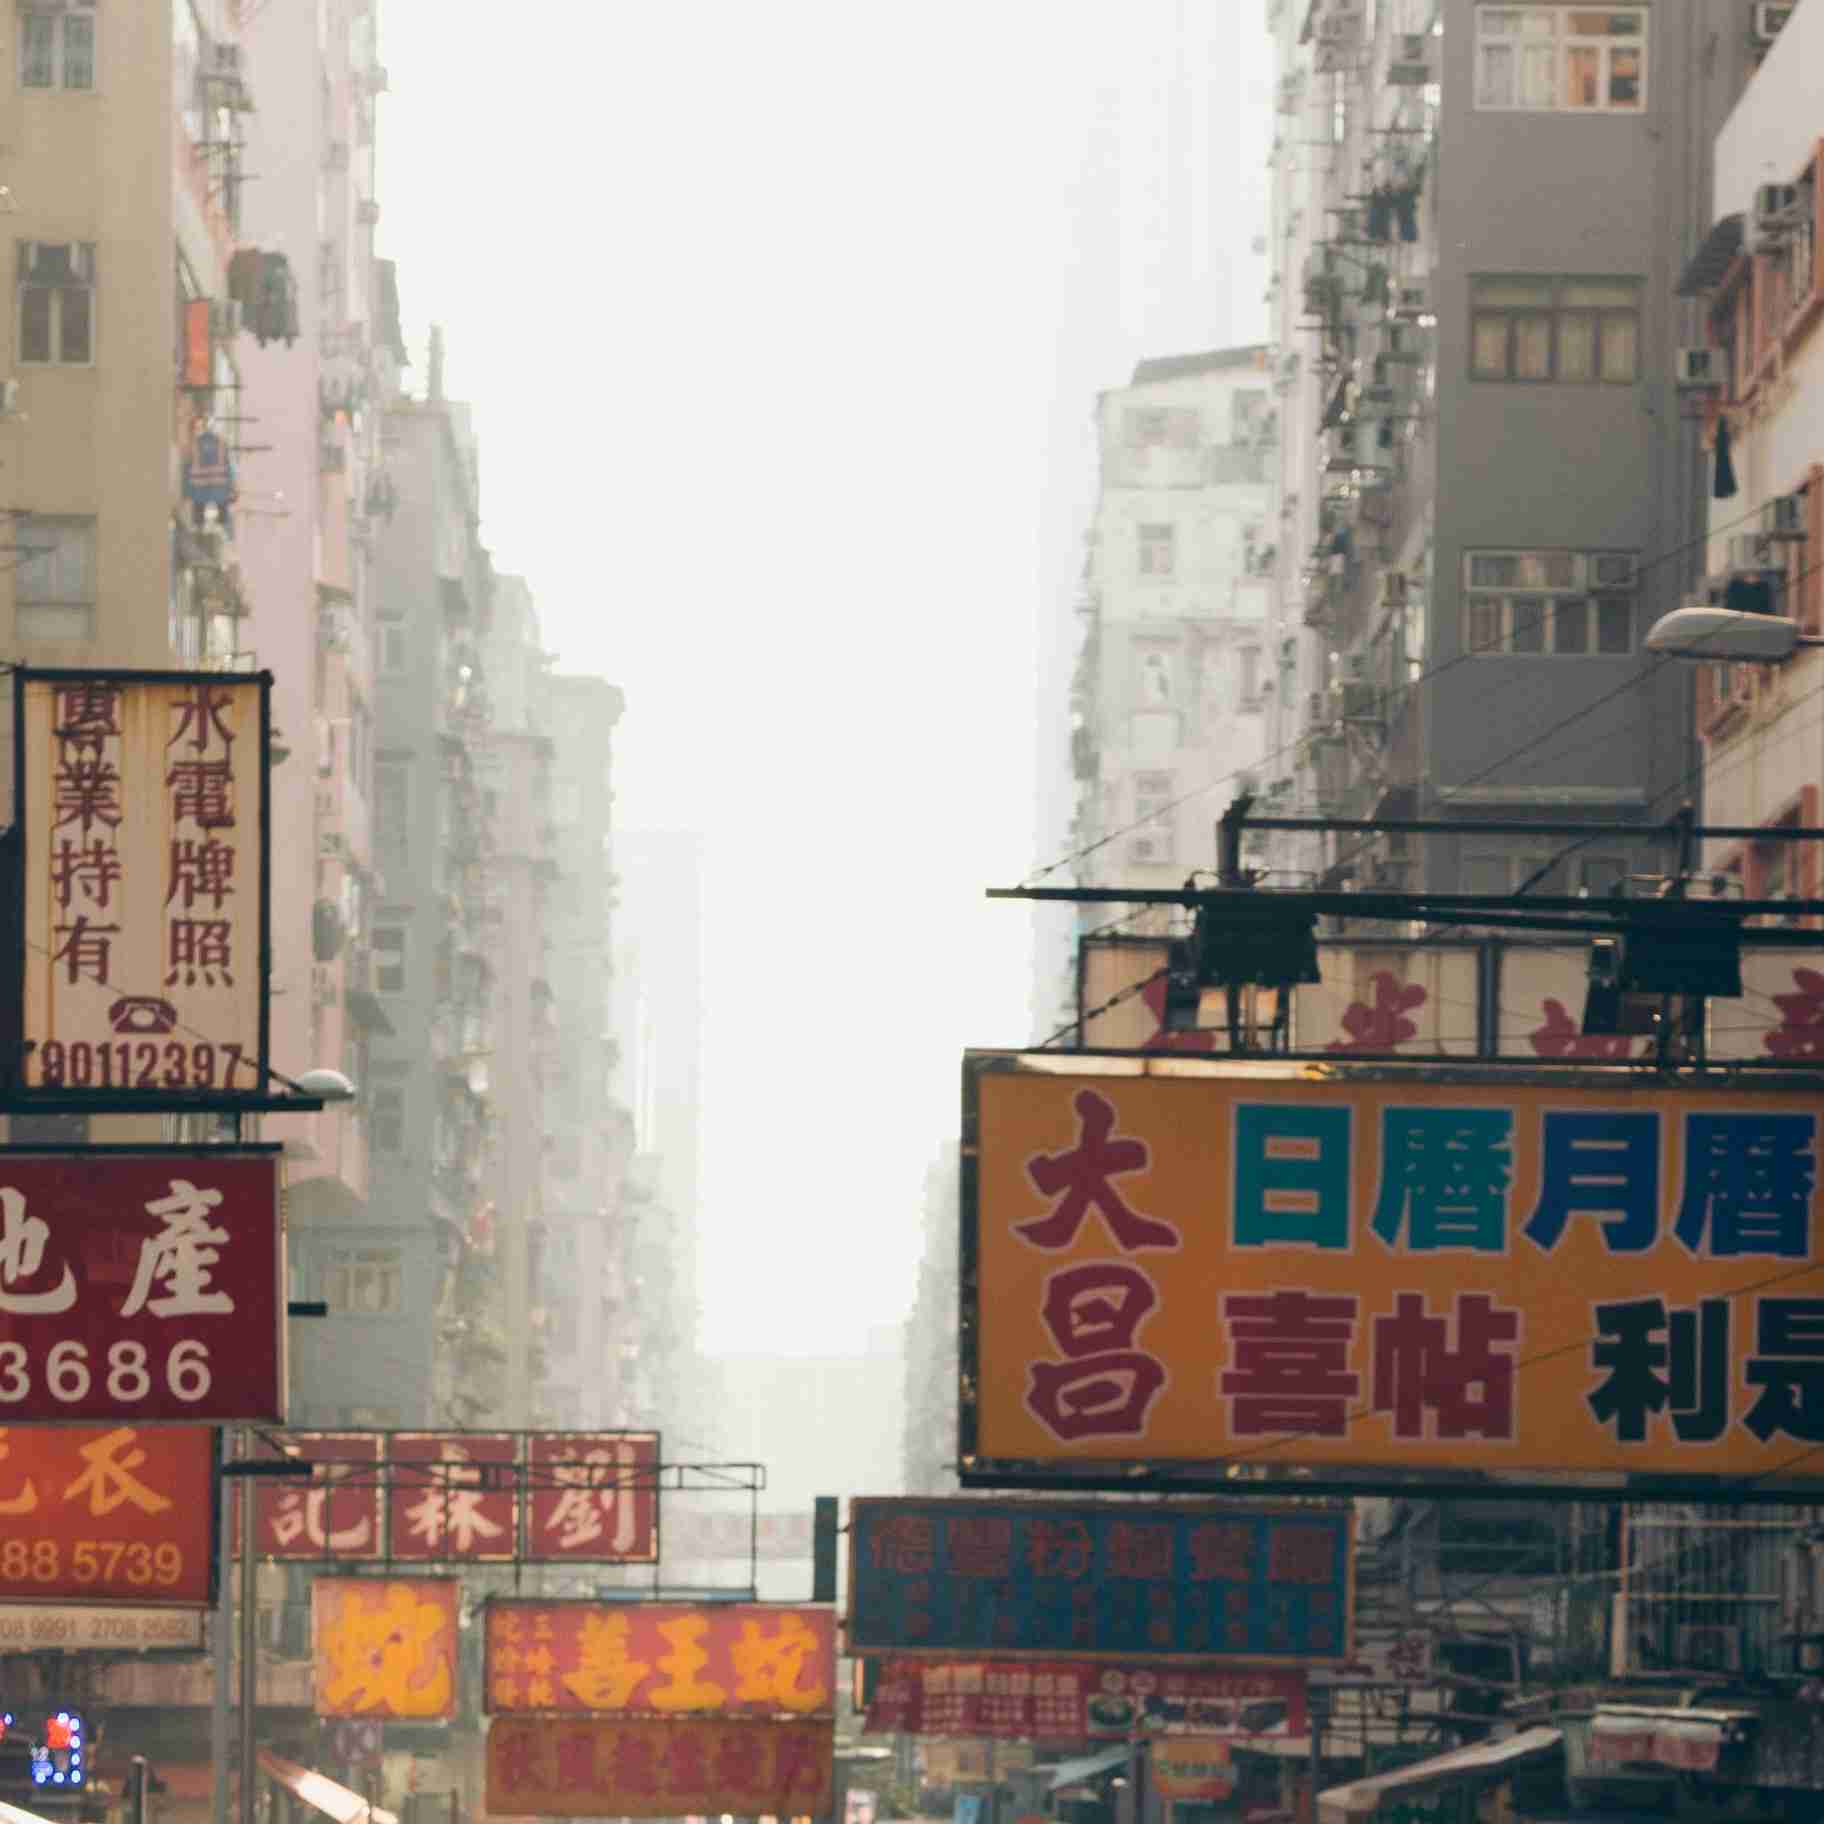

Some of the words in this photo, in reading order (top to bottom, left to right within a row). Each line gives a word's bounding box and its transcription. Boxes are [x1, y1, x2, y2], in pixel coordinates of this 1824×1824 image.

[164, 684, 236, 988] 水電牌照
[1012, 1088, 1180, 1441] 大昌
[72, 1540, 183, 1586] 5739
